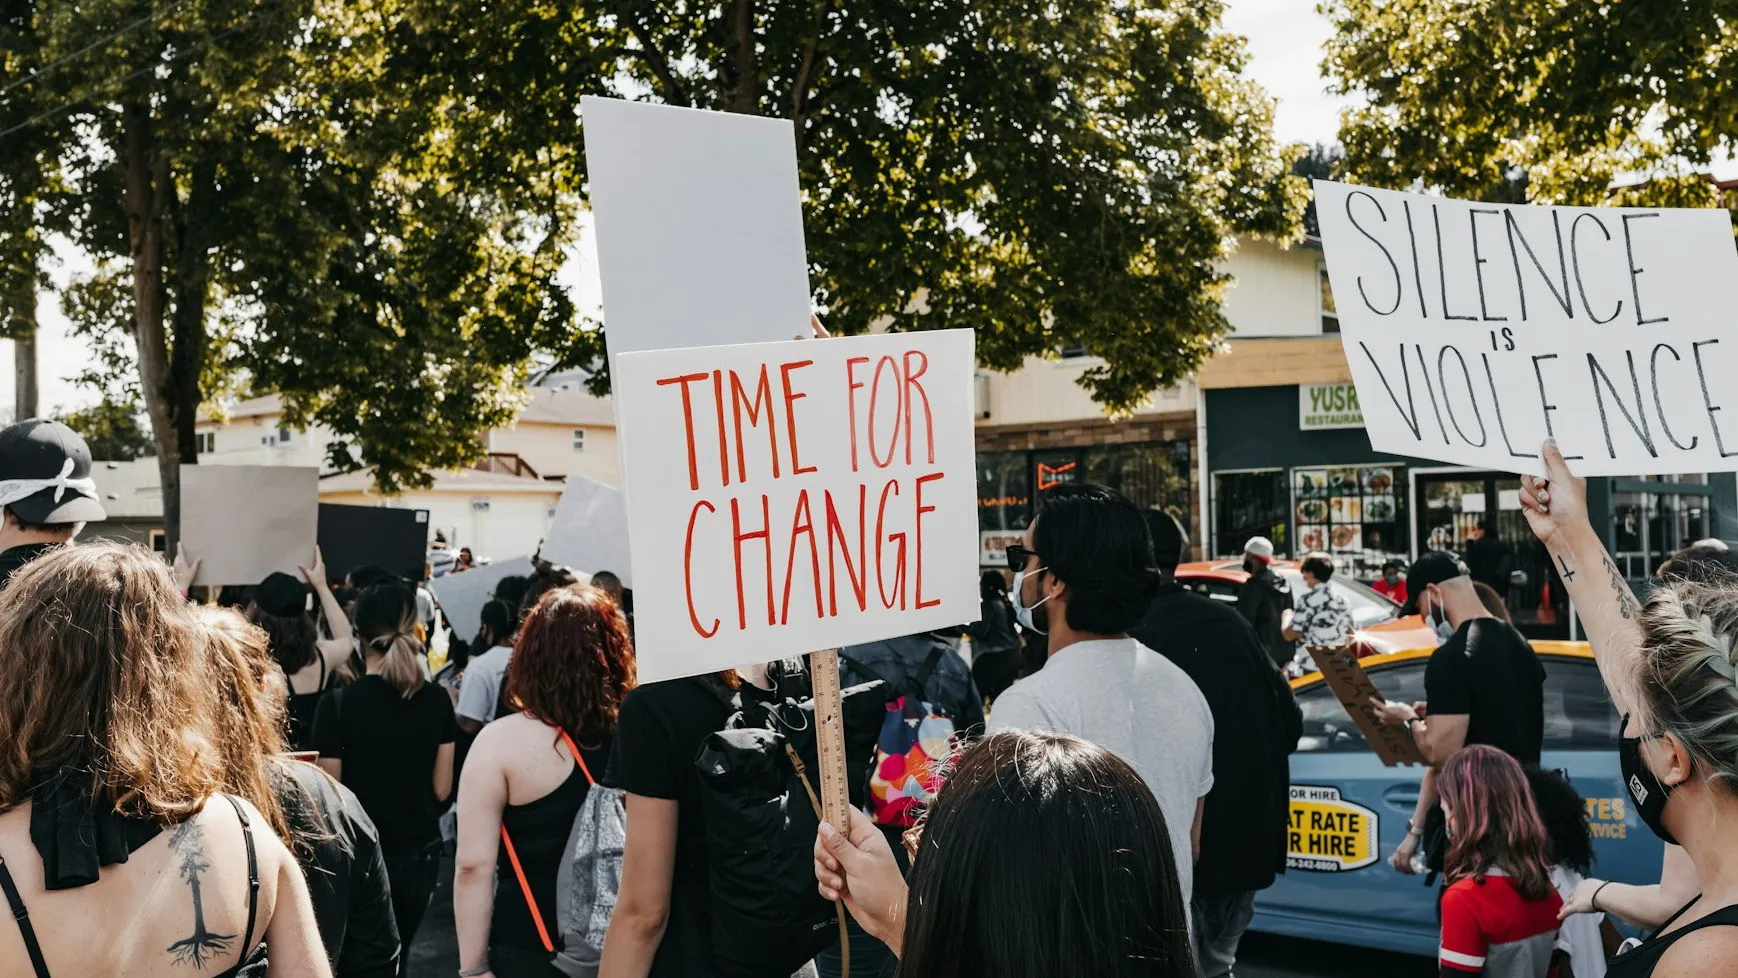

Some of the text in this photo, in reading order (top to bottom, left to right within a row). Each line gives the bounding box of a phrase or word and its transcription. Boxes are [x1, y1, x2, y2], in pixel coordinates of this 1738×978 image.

[1345, 190, 1670, 326] SILENCE
[1489, 326, 1516, 352] IS
[656, 350, 935, 491] TIME FOR
[1358, 338, 1738, 460] VIOLENCE
[684, 472, 945, 639] CHANGE
[1310, 790, 1337, 801] HIRE
[1311, 811, 1360, 833] RATE
[1309, 833, 1356, 857] HIRE
